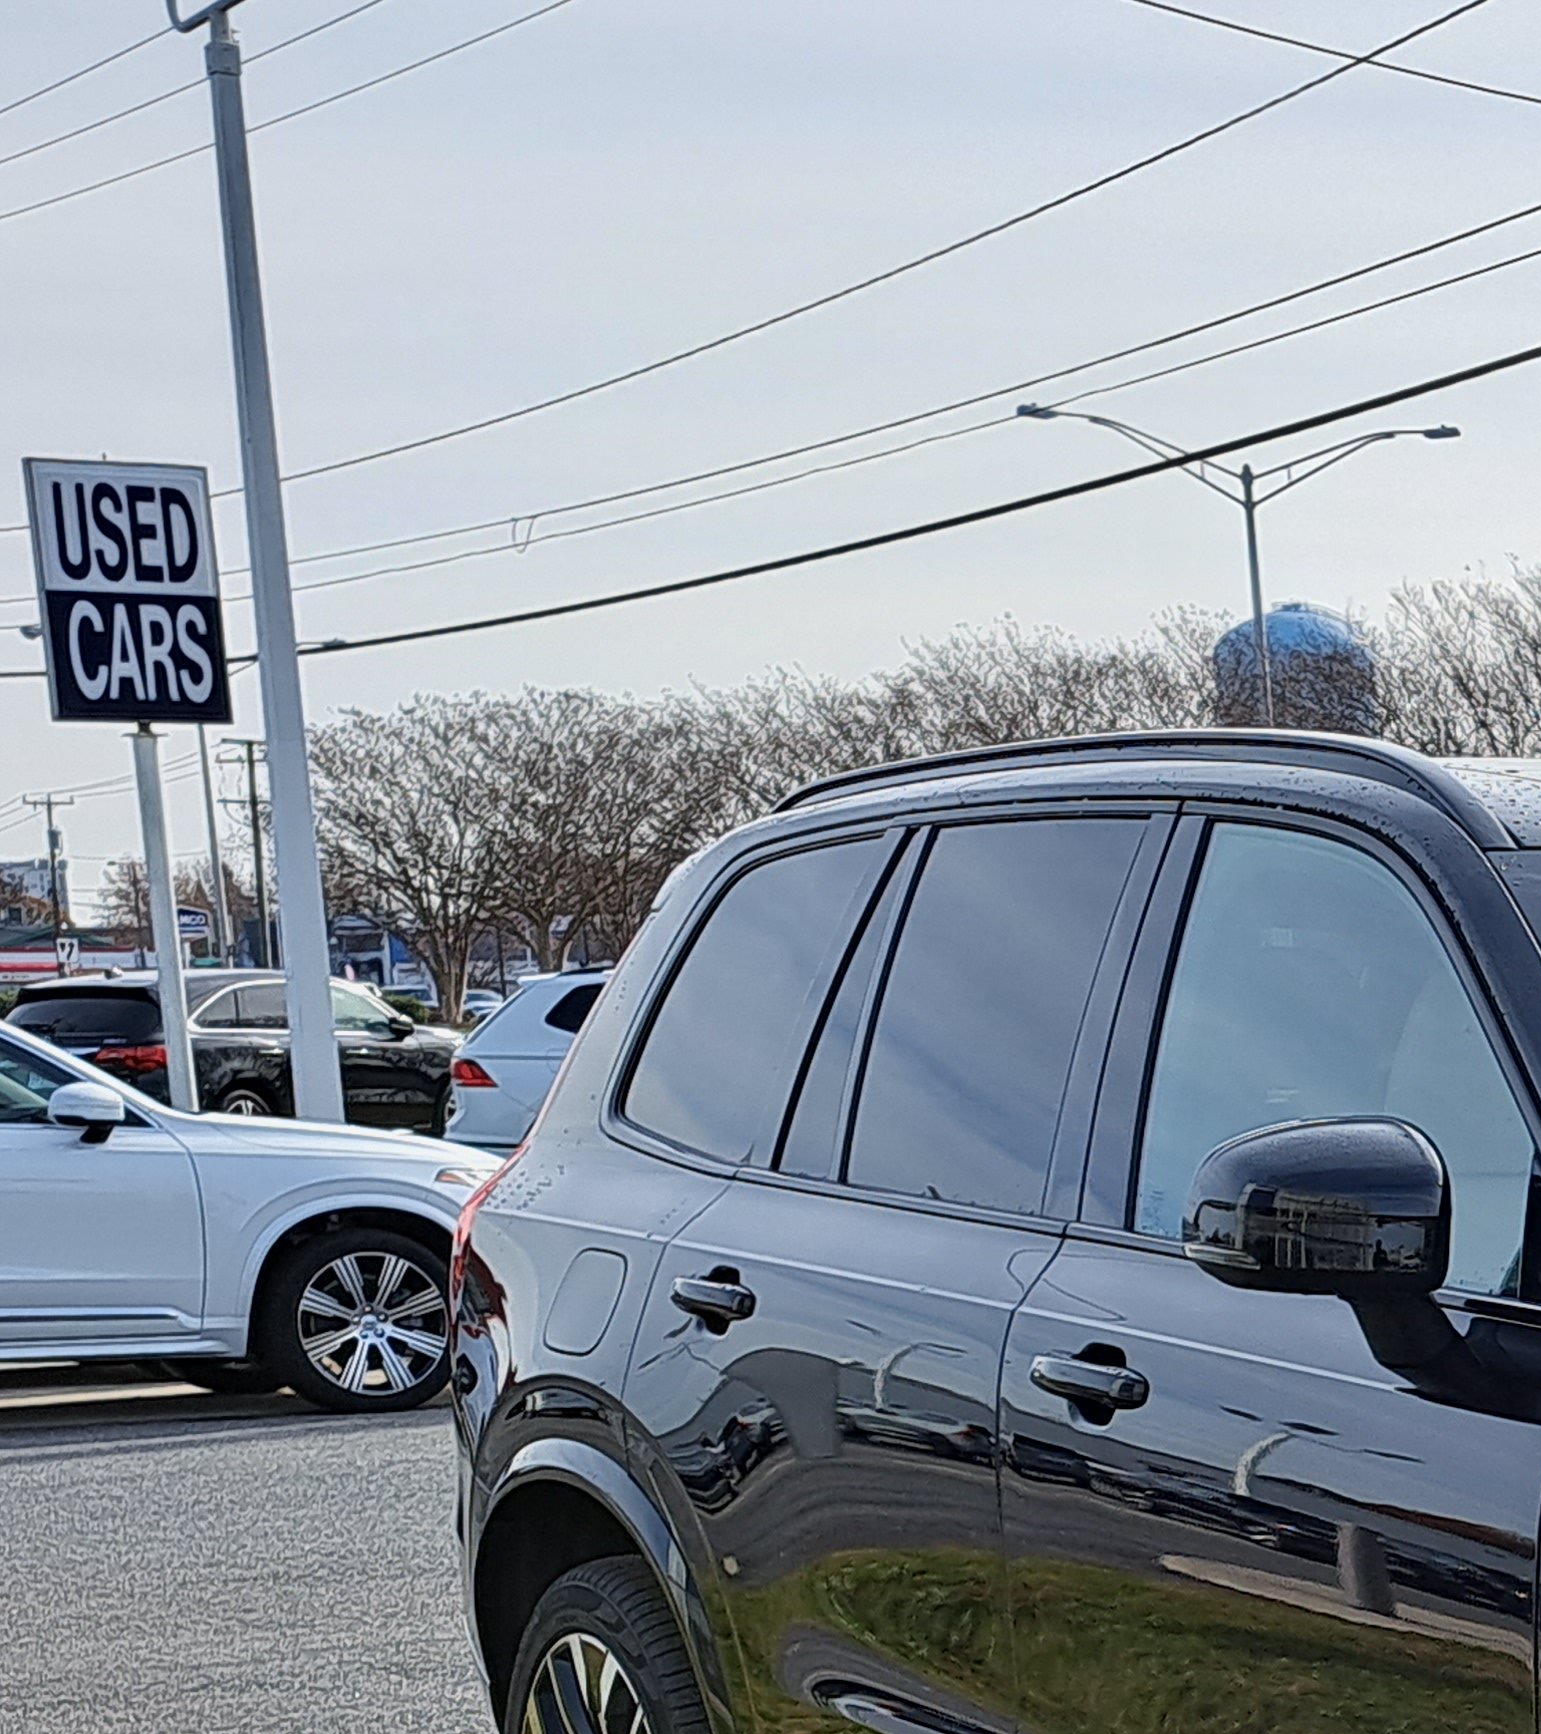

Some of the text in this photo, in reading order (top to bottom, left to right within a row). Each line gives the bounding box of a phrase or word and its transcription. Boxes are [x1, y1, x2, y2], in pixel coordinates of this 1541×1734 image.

[52, 481, 198, 583] USED
[69, 600, 213, 703] CARS
[179, 914, 206, 925] MCO
